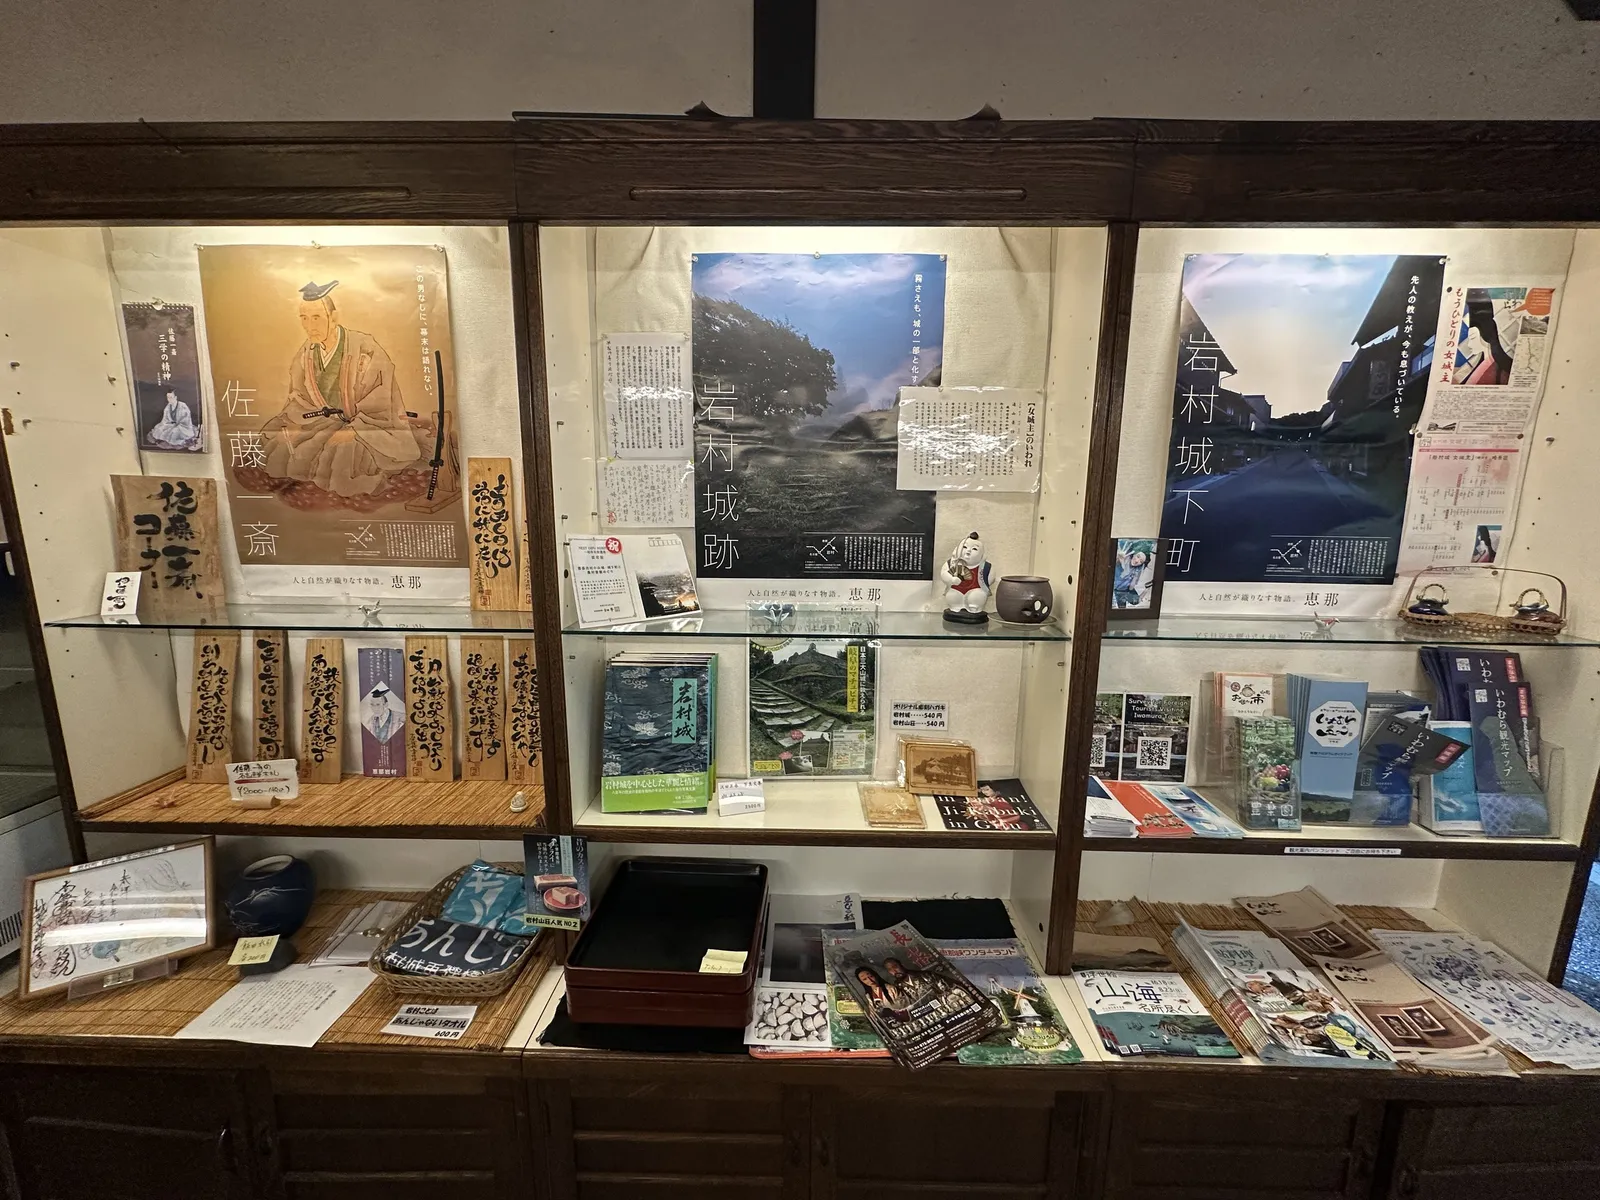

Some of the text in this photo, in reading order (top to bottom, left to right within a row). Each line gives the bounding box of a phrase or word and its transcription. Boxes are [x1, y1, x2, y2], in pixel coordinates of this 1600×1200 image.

[1440, 287, 1463, 383] もうひとりの女城主
[1393, 275, 1419, 418] 先人の教えが、今も息づいている。
[158, 334, 172, 381] 三学の精神
[1024, 402, 1036, 468] 【女城主】のいわれ
[1165, 331, 1223, 573] 岩村城下町
[221, 379, 280, 557] 佐藤一斎
[700, 381, 740, 571] 岩村城跡
[607, 538, 620, 552] 祝
[292, 574, 422, 589] 人と自然が織りなす物語。 恵那
[747, 587, 881, 601] 人と自然が織りなす物語。 恵那
[1198, 591, 1340, 606] 人と自然が織りなす物語。 恵那
[1128, 697, 1150, 706] Survey
[673, 681, 696, 741] 岩村城
[1159, 706, 1184, 714] Visiting
[1495, 689, 1515, 777] いわむら観光マップ
[943, 806, 1038, 816] Ji-Kabuki
[949, 818, 1022, 831] in Gifu
[525, 916, 563, 927] 岩村山荘人気
[1095, 977, 1164, 1004] 山海
[392, 1017, 467, 1029] あんじゃないタオル
[434, 1031, 460, 1039] 600円
